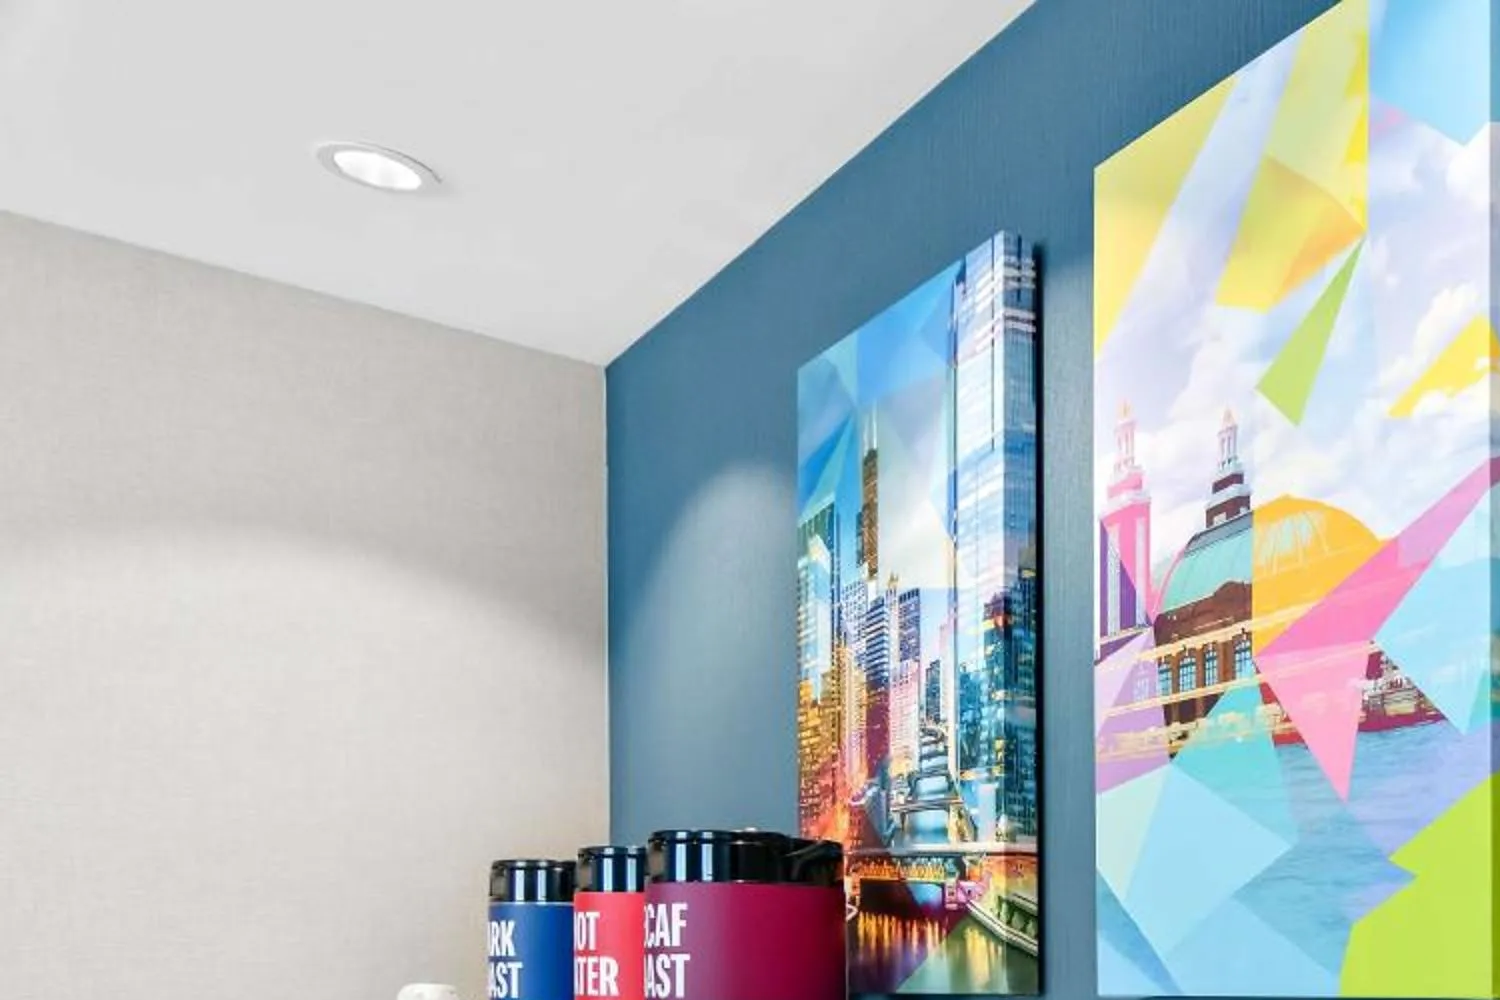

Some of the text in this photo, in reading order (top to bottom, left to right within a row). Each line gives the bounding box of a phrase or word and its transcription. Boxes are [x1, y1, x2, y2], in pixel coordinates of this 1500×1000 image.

[488, 920, 516, 956] RK
[574, 911, 600, 951] OT
[643, 902, 688, 948] CAF
[644, 953, 691, 999] AST
